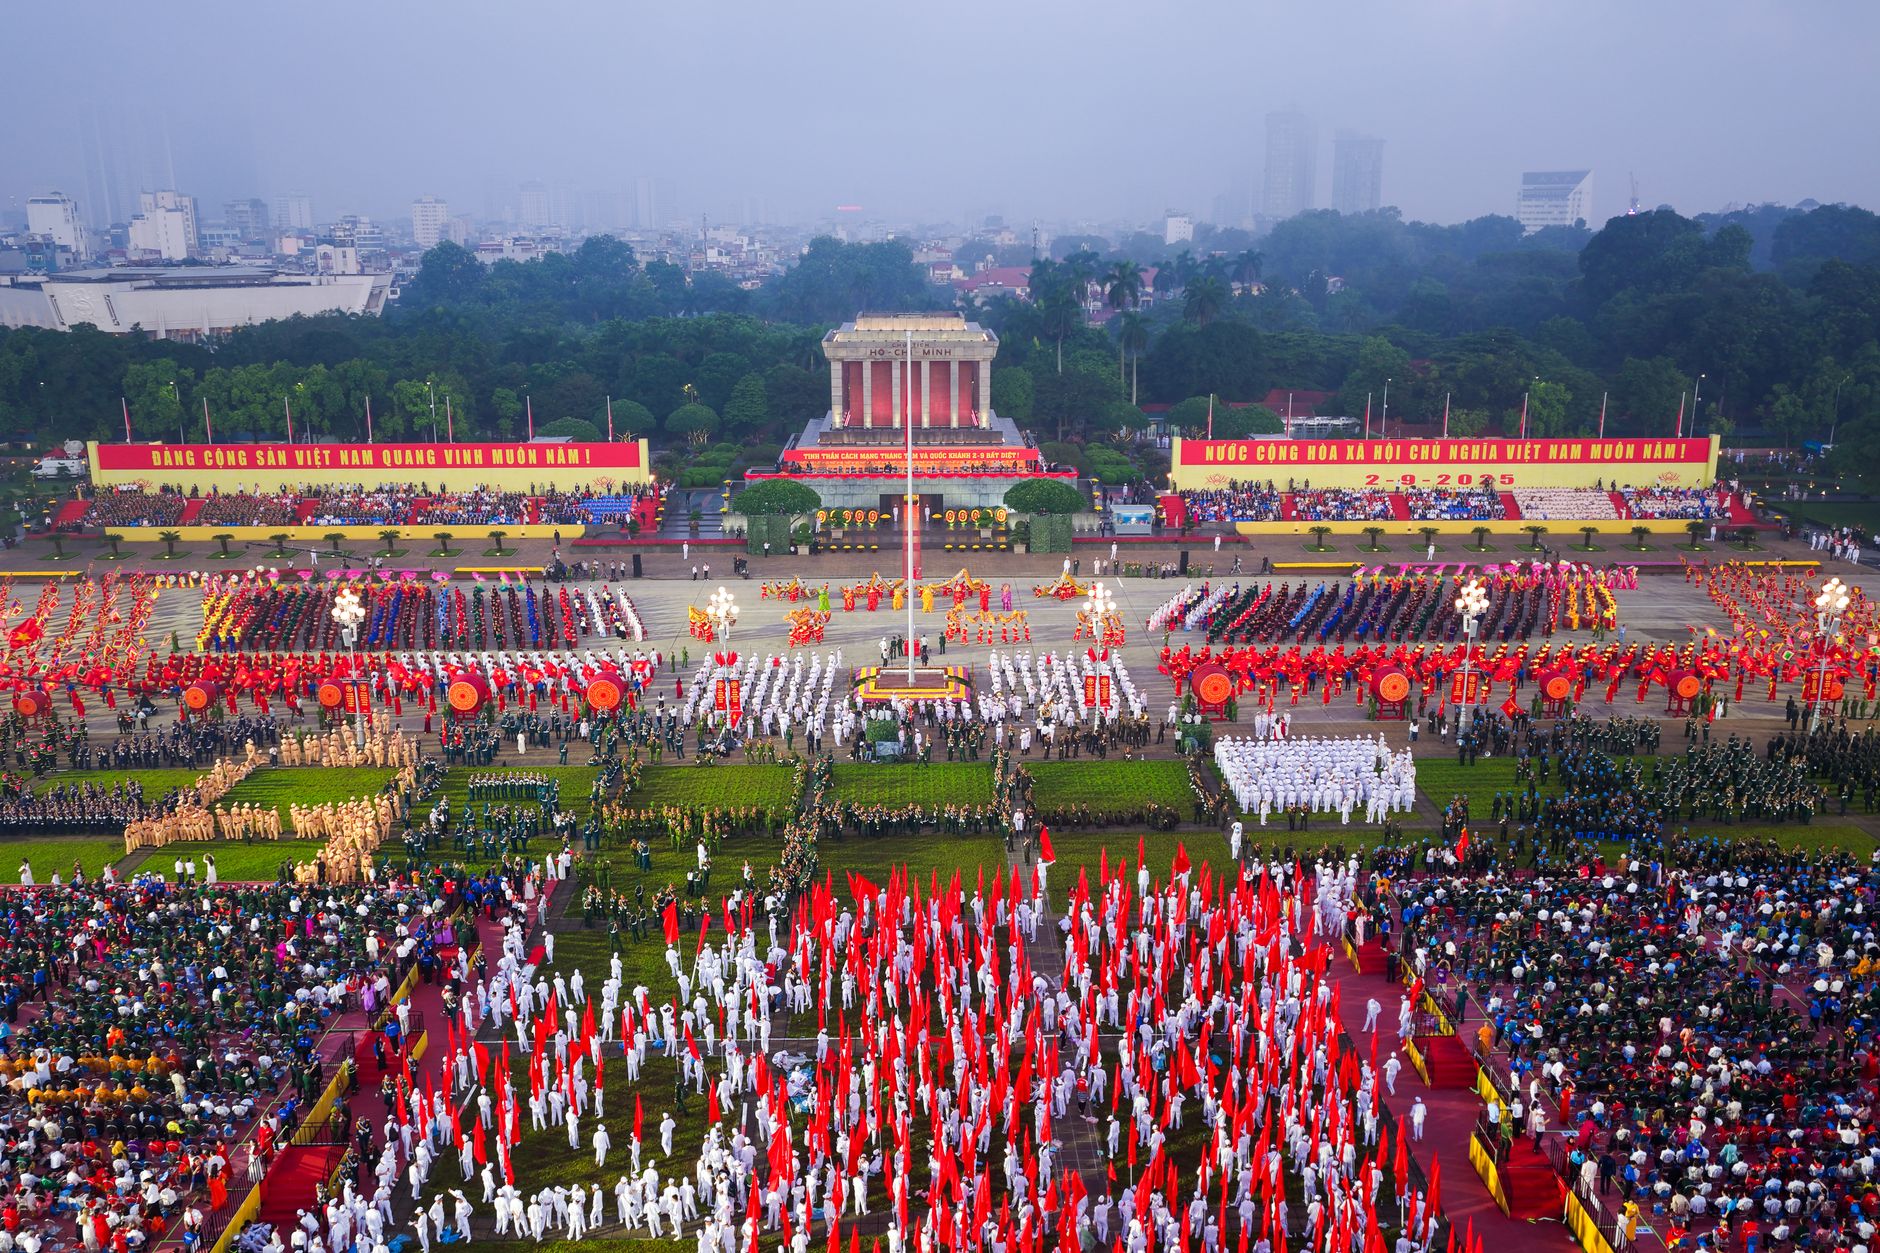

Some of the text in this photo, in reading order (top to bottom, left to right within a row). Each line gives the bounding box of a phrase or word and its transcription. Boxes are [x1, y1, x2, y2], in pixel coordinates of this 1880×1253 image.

[151, 446, 195, 466] ĐẢNG
[203, 447, 247, 469] CỘNG
[256, 447, 287, 466] SẢN
[295, 447, 331, 468] VIỆT
[339, 450, 373, 465] NAM
[382, 449, 436, 467] QUANG
[444, 449, 483, 465] VINH
[492, 447, 537, 465] MUÔN
[841, 452, 859, 460] CÁCH
[860, 453, 879, 461] MẠNG
[904, 452, 919, 460] TM
[1205, 442, 1248, 461] NƯỚC
[1256, 443, 1298, 463] CỘNG
[1307, 443, 1337, 461] HÒA
[1346, 443, 1365, 461] XÃ
[1374, 443, 1401, 463] HỘI
[1409, 441, 1441, 461] CHỦ
[1449, 443, 1498, 460] NGHĨA
[1506, 442, 1541, 462] VIỆT
[1549, 444, 1582, 460] NAM
[1590, 442, 1634, 460] MUÔN
